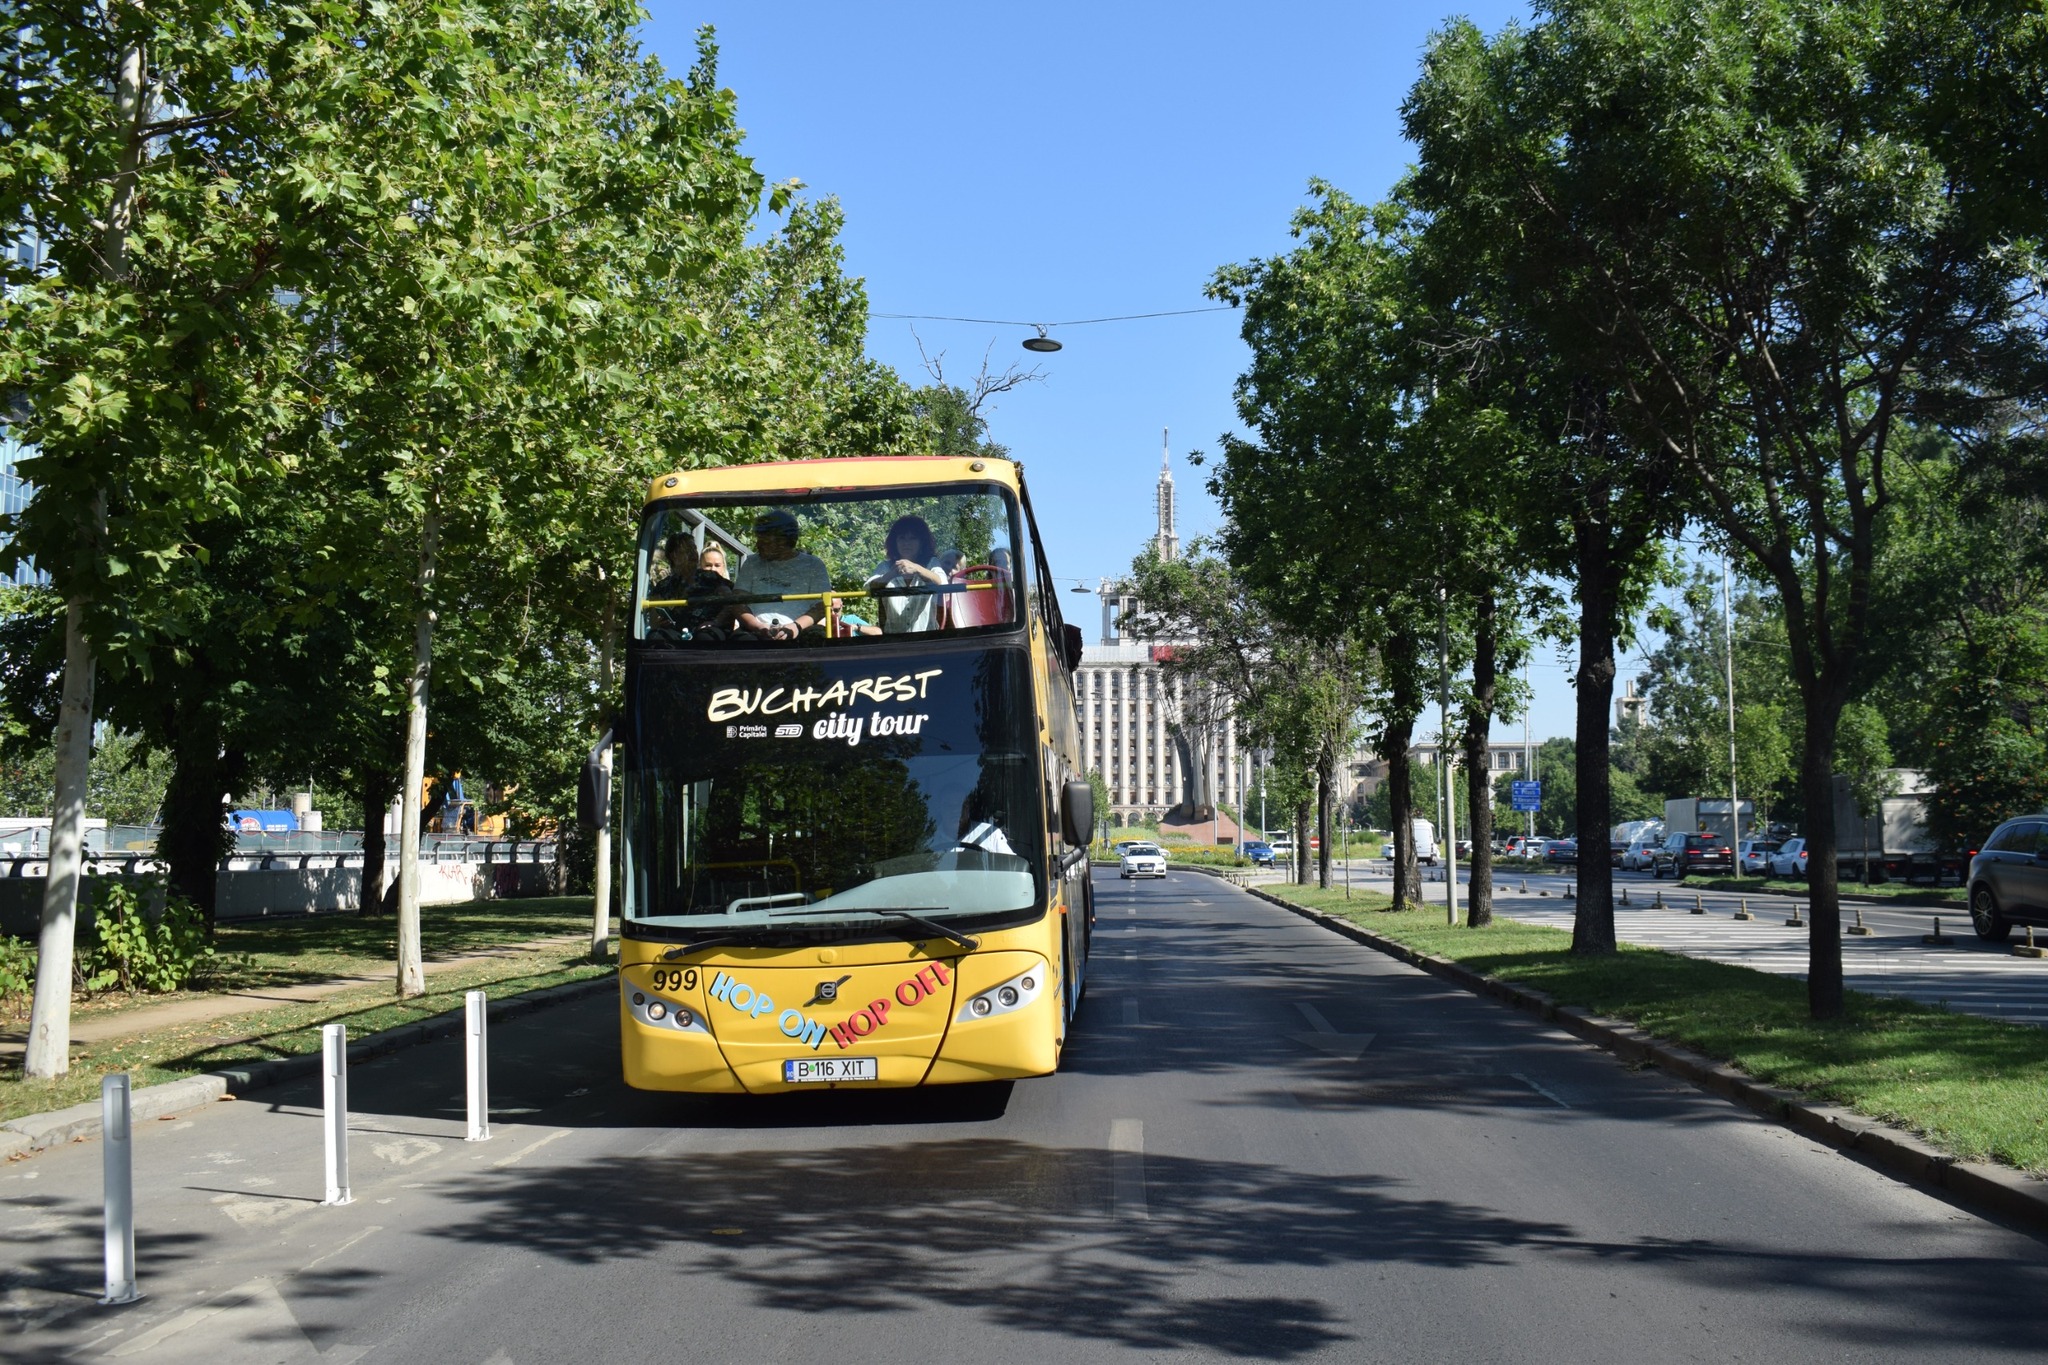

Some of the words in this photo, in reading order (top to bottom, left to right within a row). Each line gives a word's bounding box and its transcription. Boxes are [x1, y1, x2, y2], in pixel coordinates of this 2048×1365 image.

[707, 669, 943, 722] BUCHAREST
[774, 726, 800, 735] STB
[813, 711, 863, 746] city
[869, 711, 929, 738] tour
[653, 969, 698, 992] 999
[709, 971, 775, 1018] HOP
[778, 1008, 827, 1050] ON
[829, 998, 891, 1049] HOP
[895, 960, 951, 1006] OFF
[798, 1062, 809, 1077] B
[815, 1061, 834, 1076] 116
[841, 1061, 864, 1076] XIT
